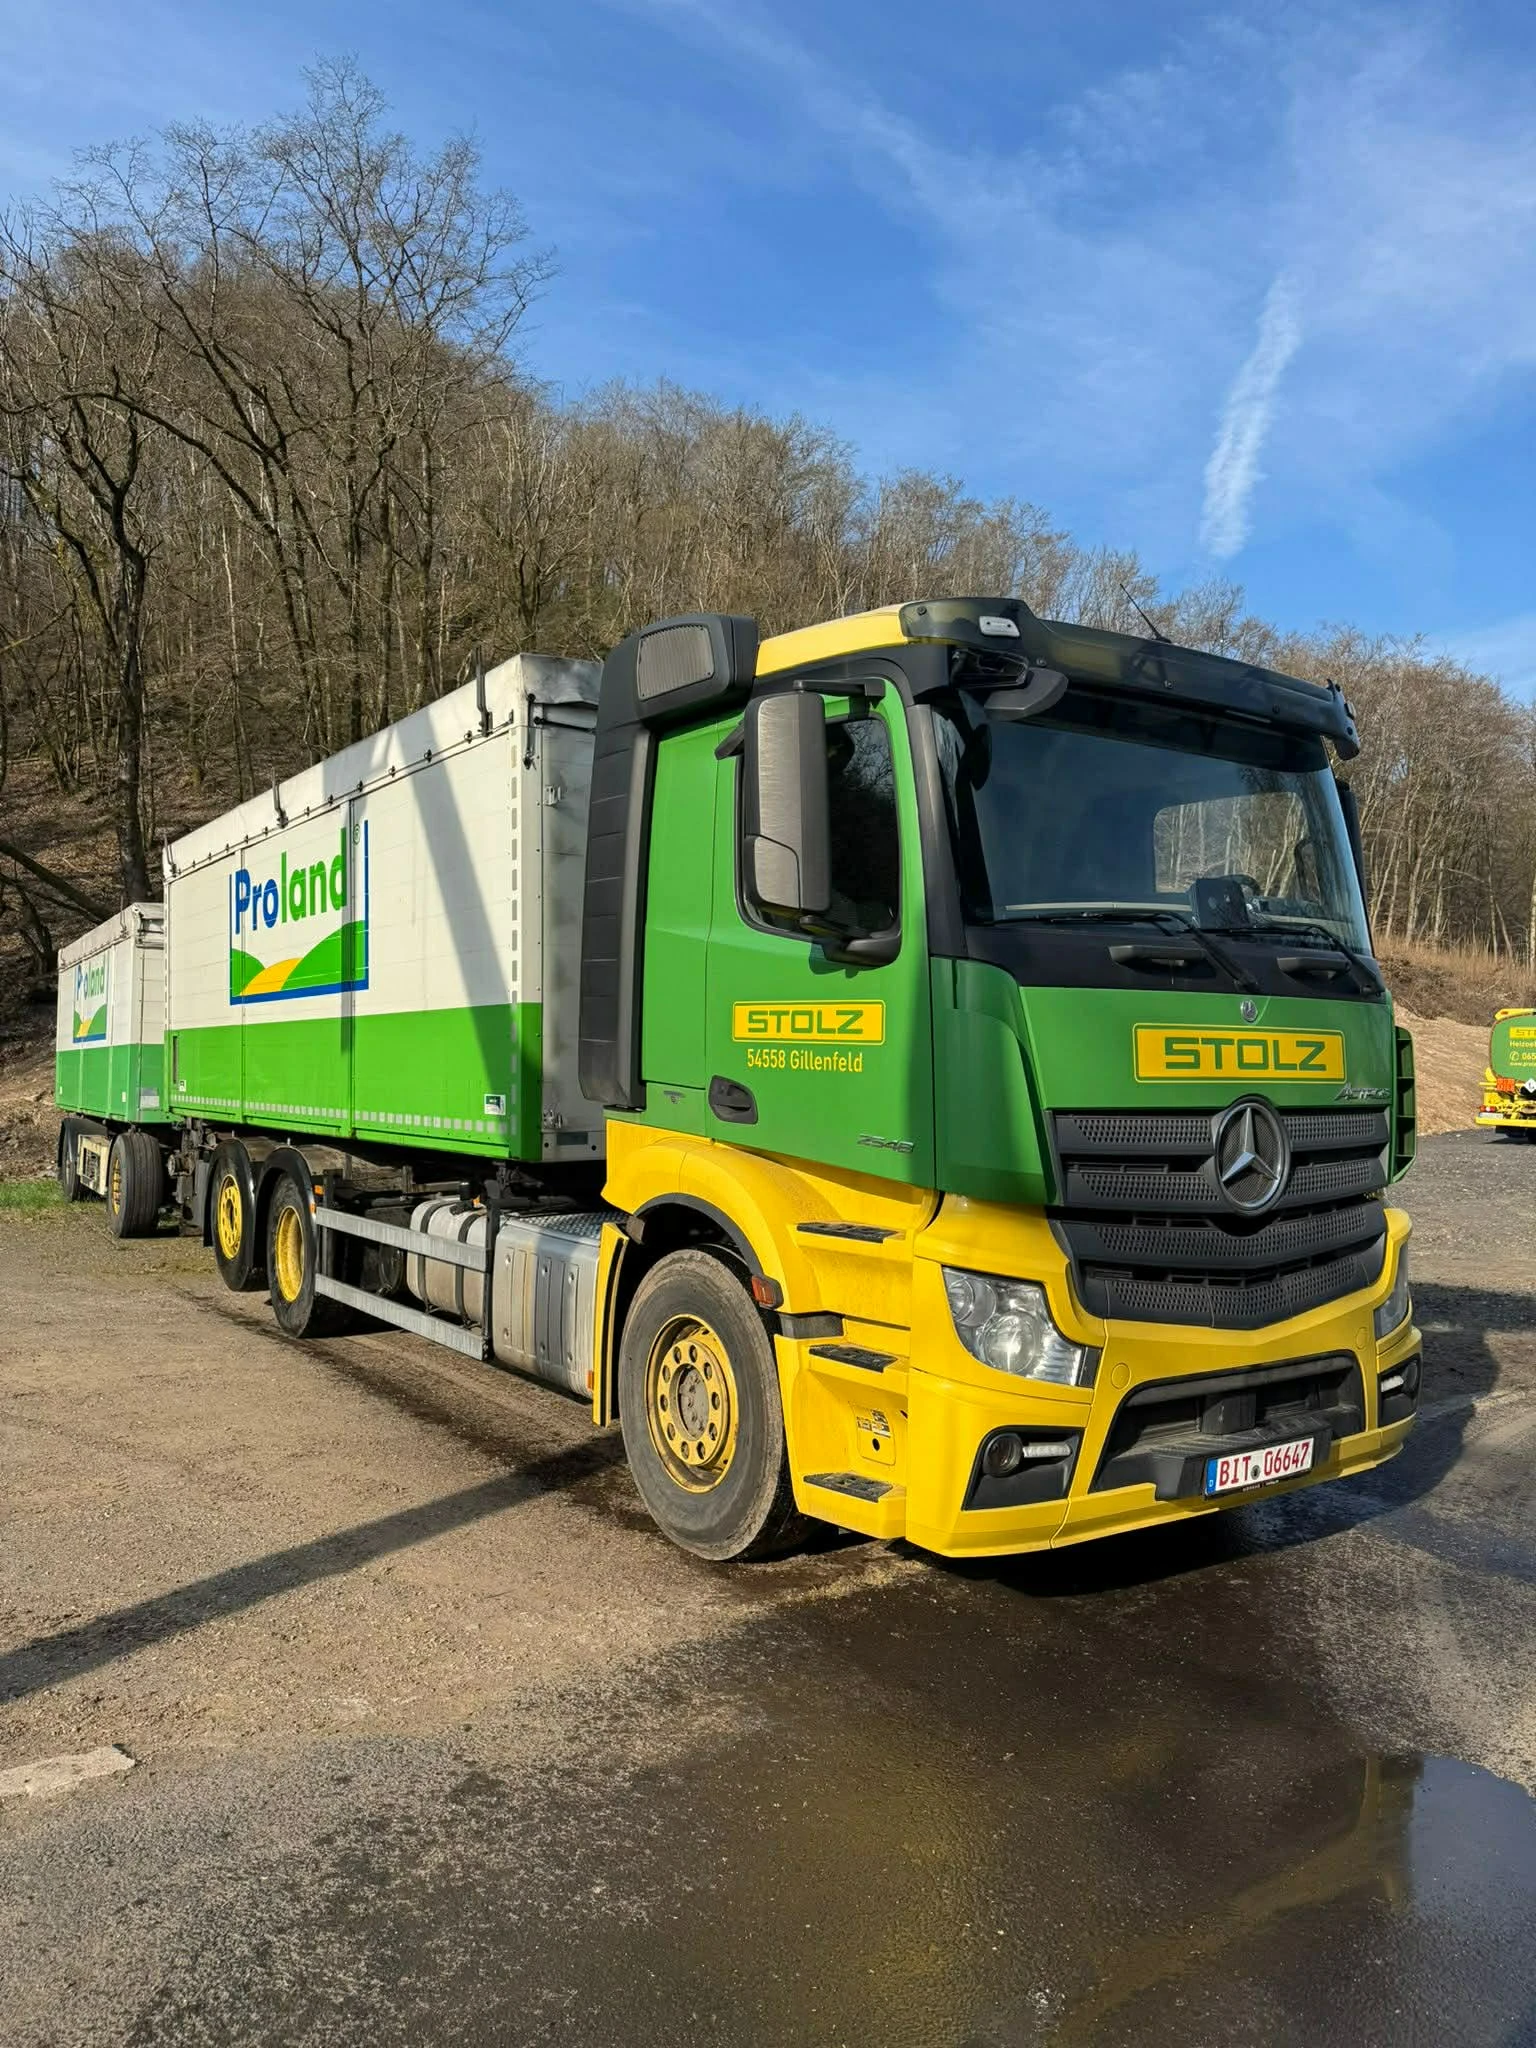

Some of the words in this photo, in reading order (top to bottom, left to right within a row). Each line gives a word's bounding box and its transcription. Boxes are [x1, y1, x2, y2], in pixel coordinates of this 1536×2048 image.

[235, 827, 347, 935] Proland
[748, 1009, 864, 1034] STOLZ
[747, 1049, 786, 1068] 54558
[790, 1050, 864, 1073] Gillenfeld
[1164, 1036, 1327, 1071] STOLZ
[1219, 1456, 1251, 1487] BIT
[1263, 1442, 1310, 1476] 06647
